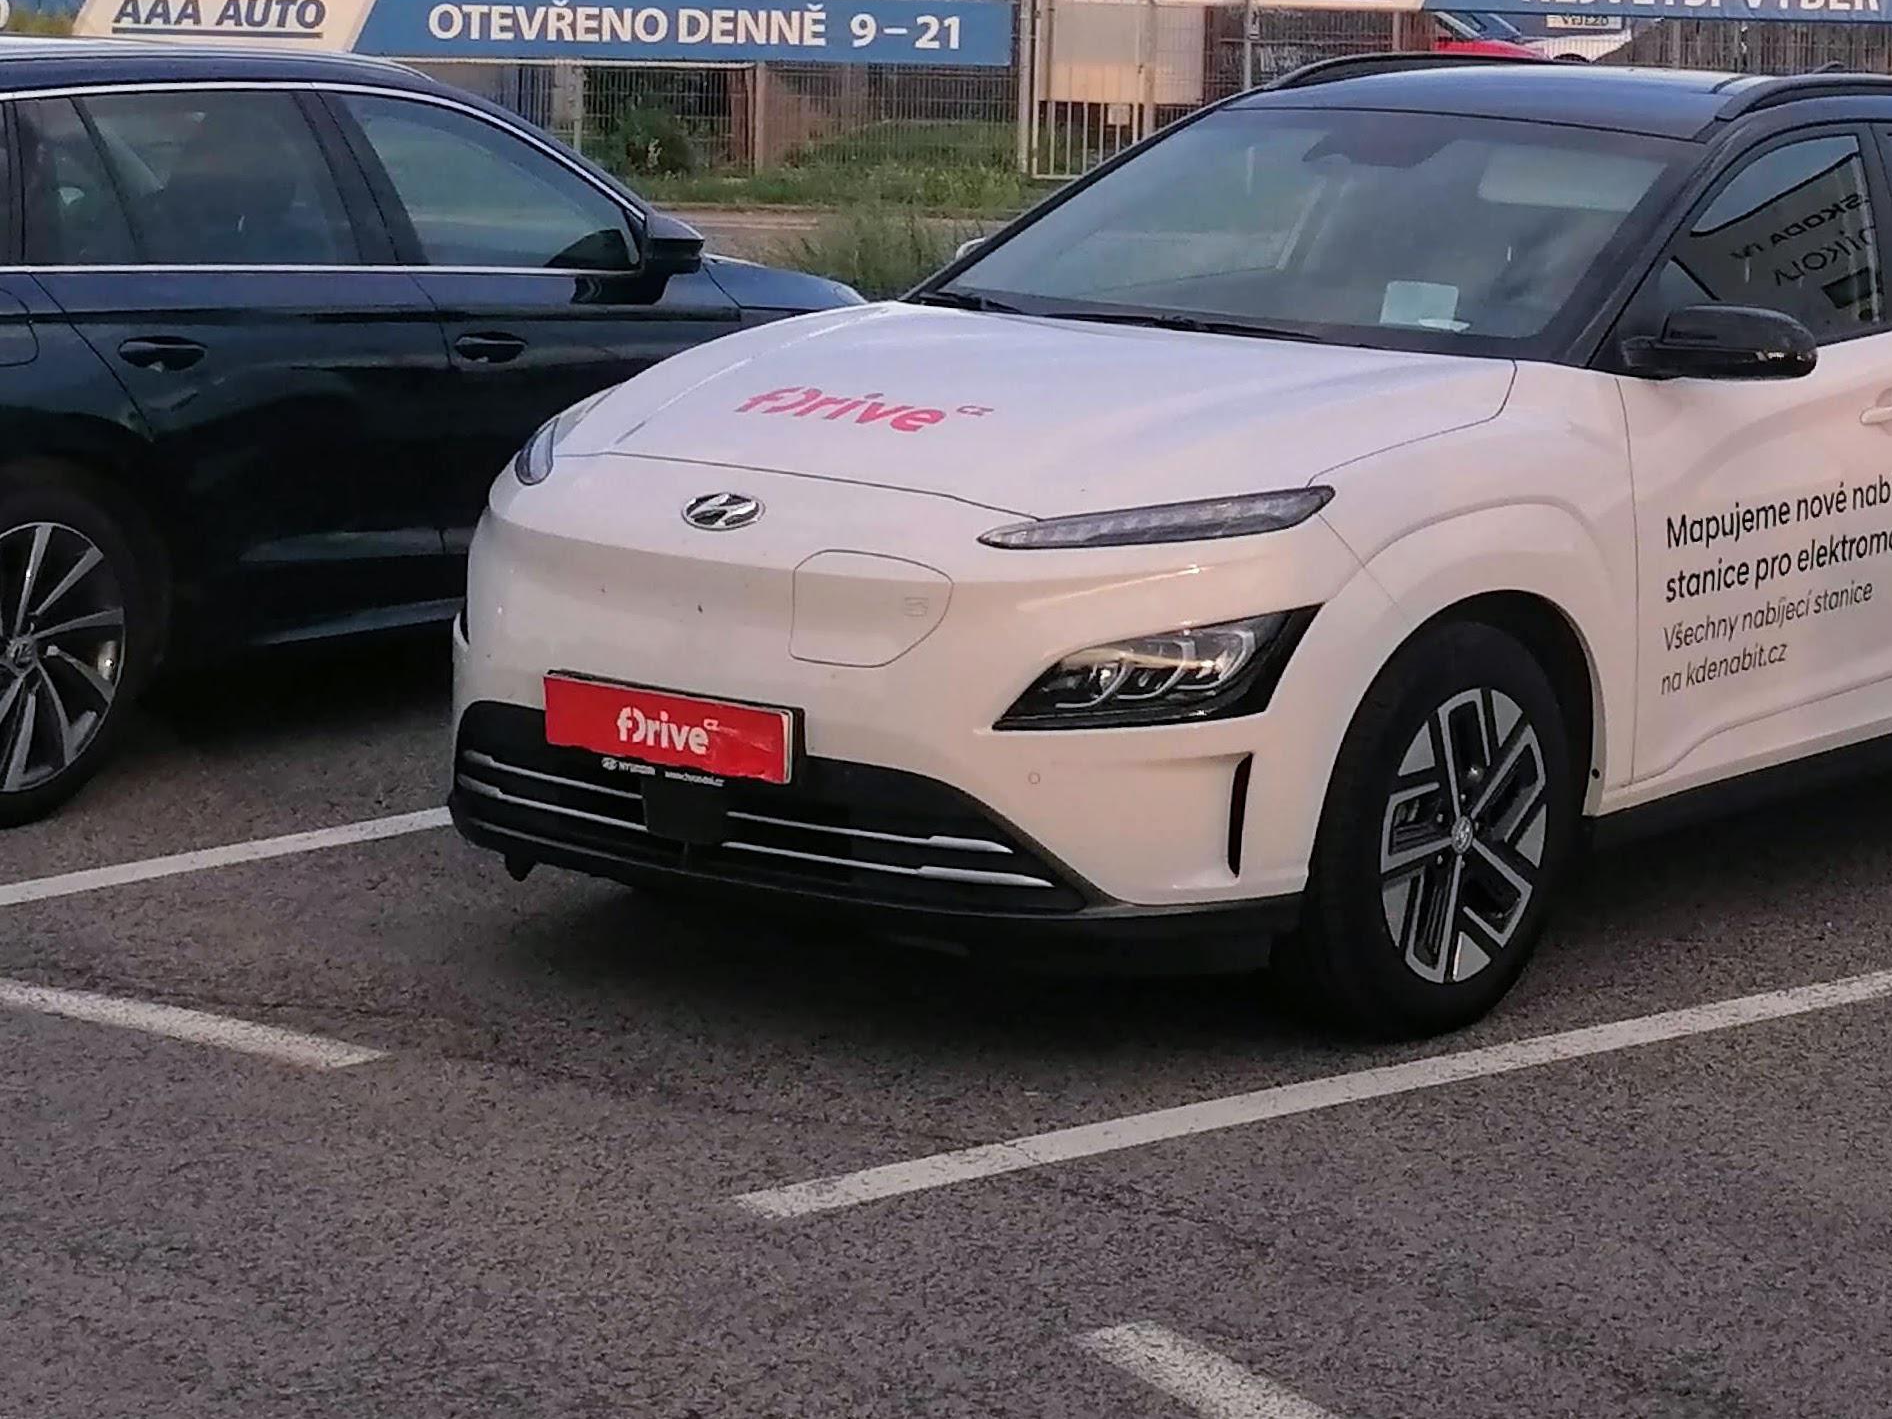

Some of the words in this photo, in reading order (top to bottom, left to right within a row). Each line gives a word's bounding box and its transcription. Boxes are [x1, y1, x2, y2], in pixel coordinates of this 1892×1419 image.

[428, 0, 667, 44] OTEVŘENO
[677, 3, 826, 48] DENNĚ
[1667, 502, 1790, 548] Mapujeme
[1796, 482, 1847, 522] nové
[1666, 558, 1750, 603] stanice
[1755, 553, 1792, 590] pro
[1663, 612, 1738, 651] Všechny
[1742, 589, 1812, 632] nabíjecí
[1814, 580, 1873, 615] stanice
[1660, 673, 1682, 695] na
[1685, 643, 1788, 688] kdenabit.cz
